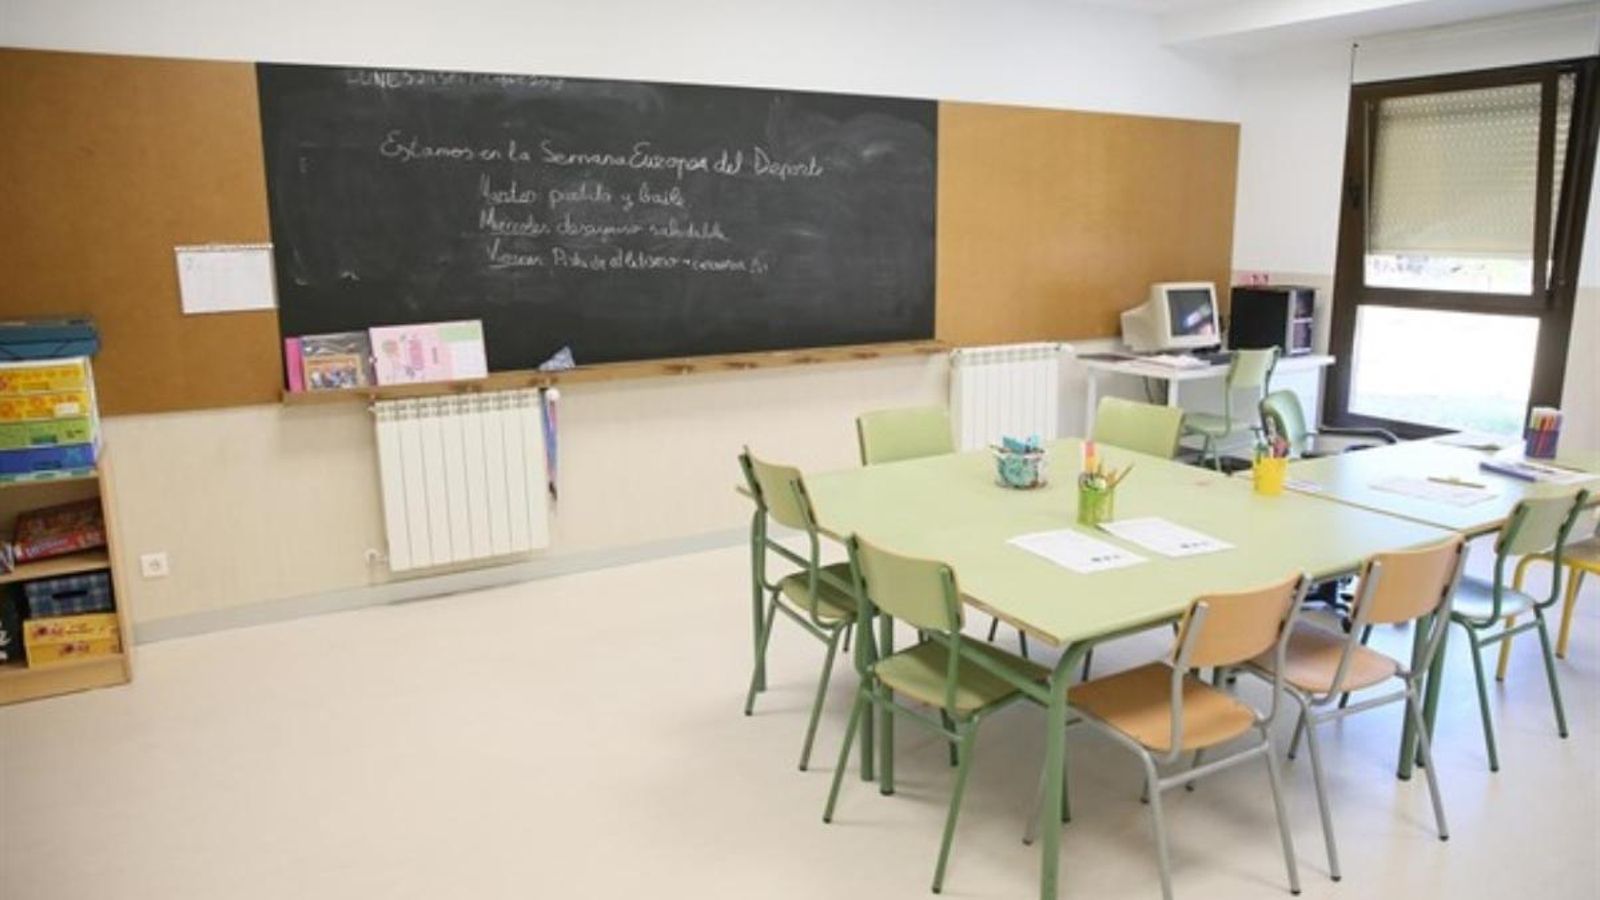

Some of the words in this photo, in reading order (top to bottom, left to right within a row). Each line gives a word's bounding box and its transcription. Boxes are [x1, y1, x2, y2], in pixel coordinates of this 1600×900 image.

[380, 129, 474, 162] Estamos
[480, 148, 500, 161] en
[508, 139, 531, 161] la
[541, 139, 626, 166] Semana
[713, 149, 744, 175] del
[754, 146, 824, 181] Deporte
[621, 192, 635, 211] y
